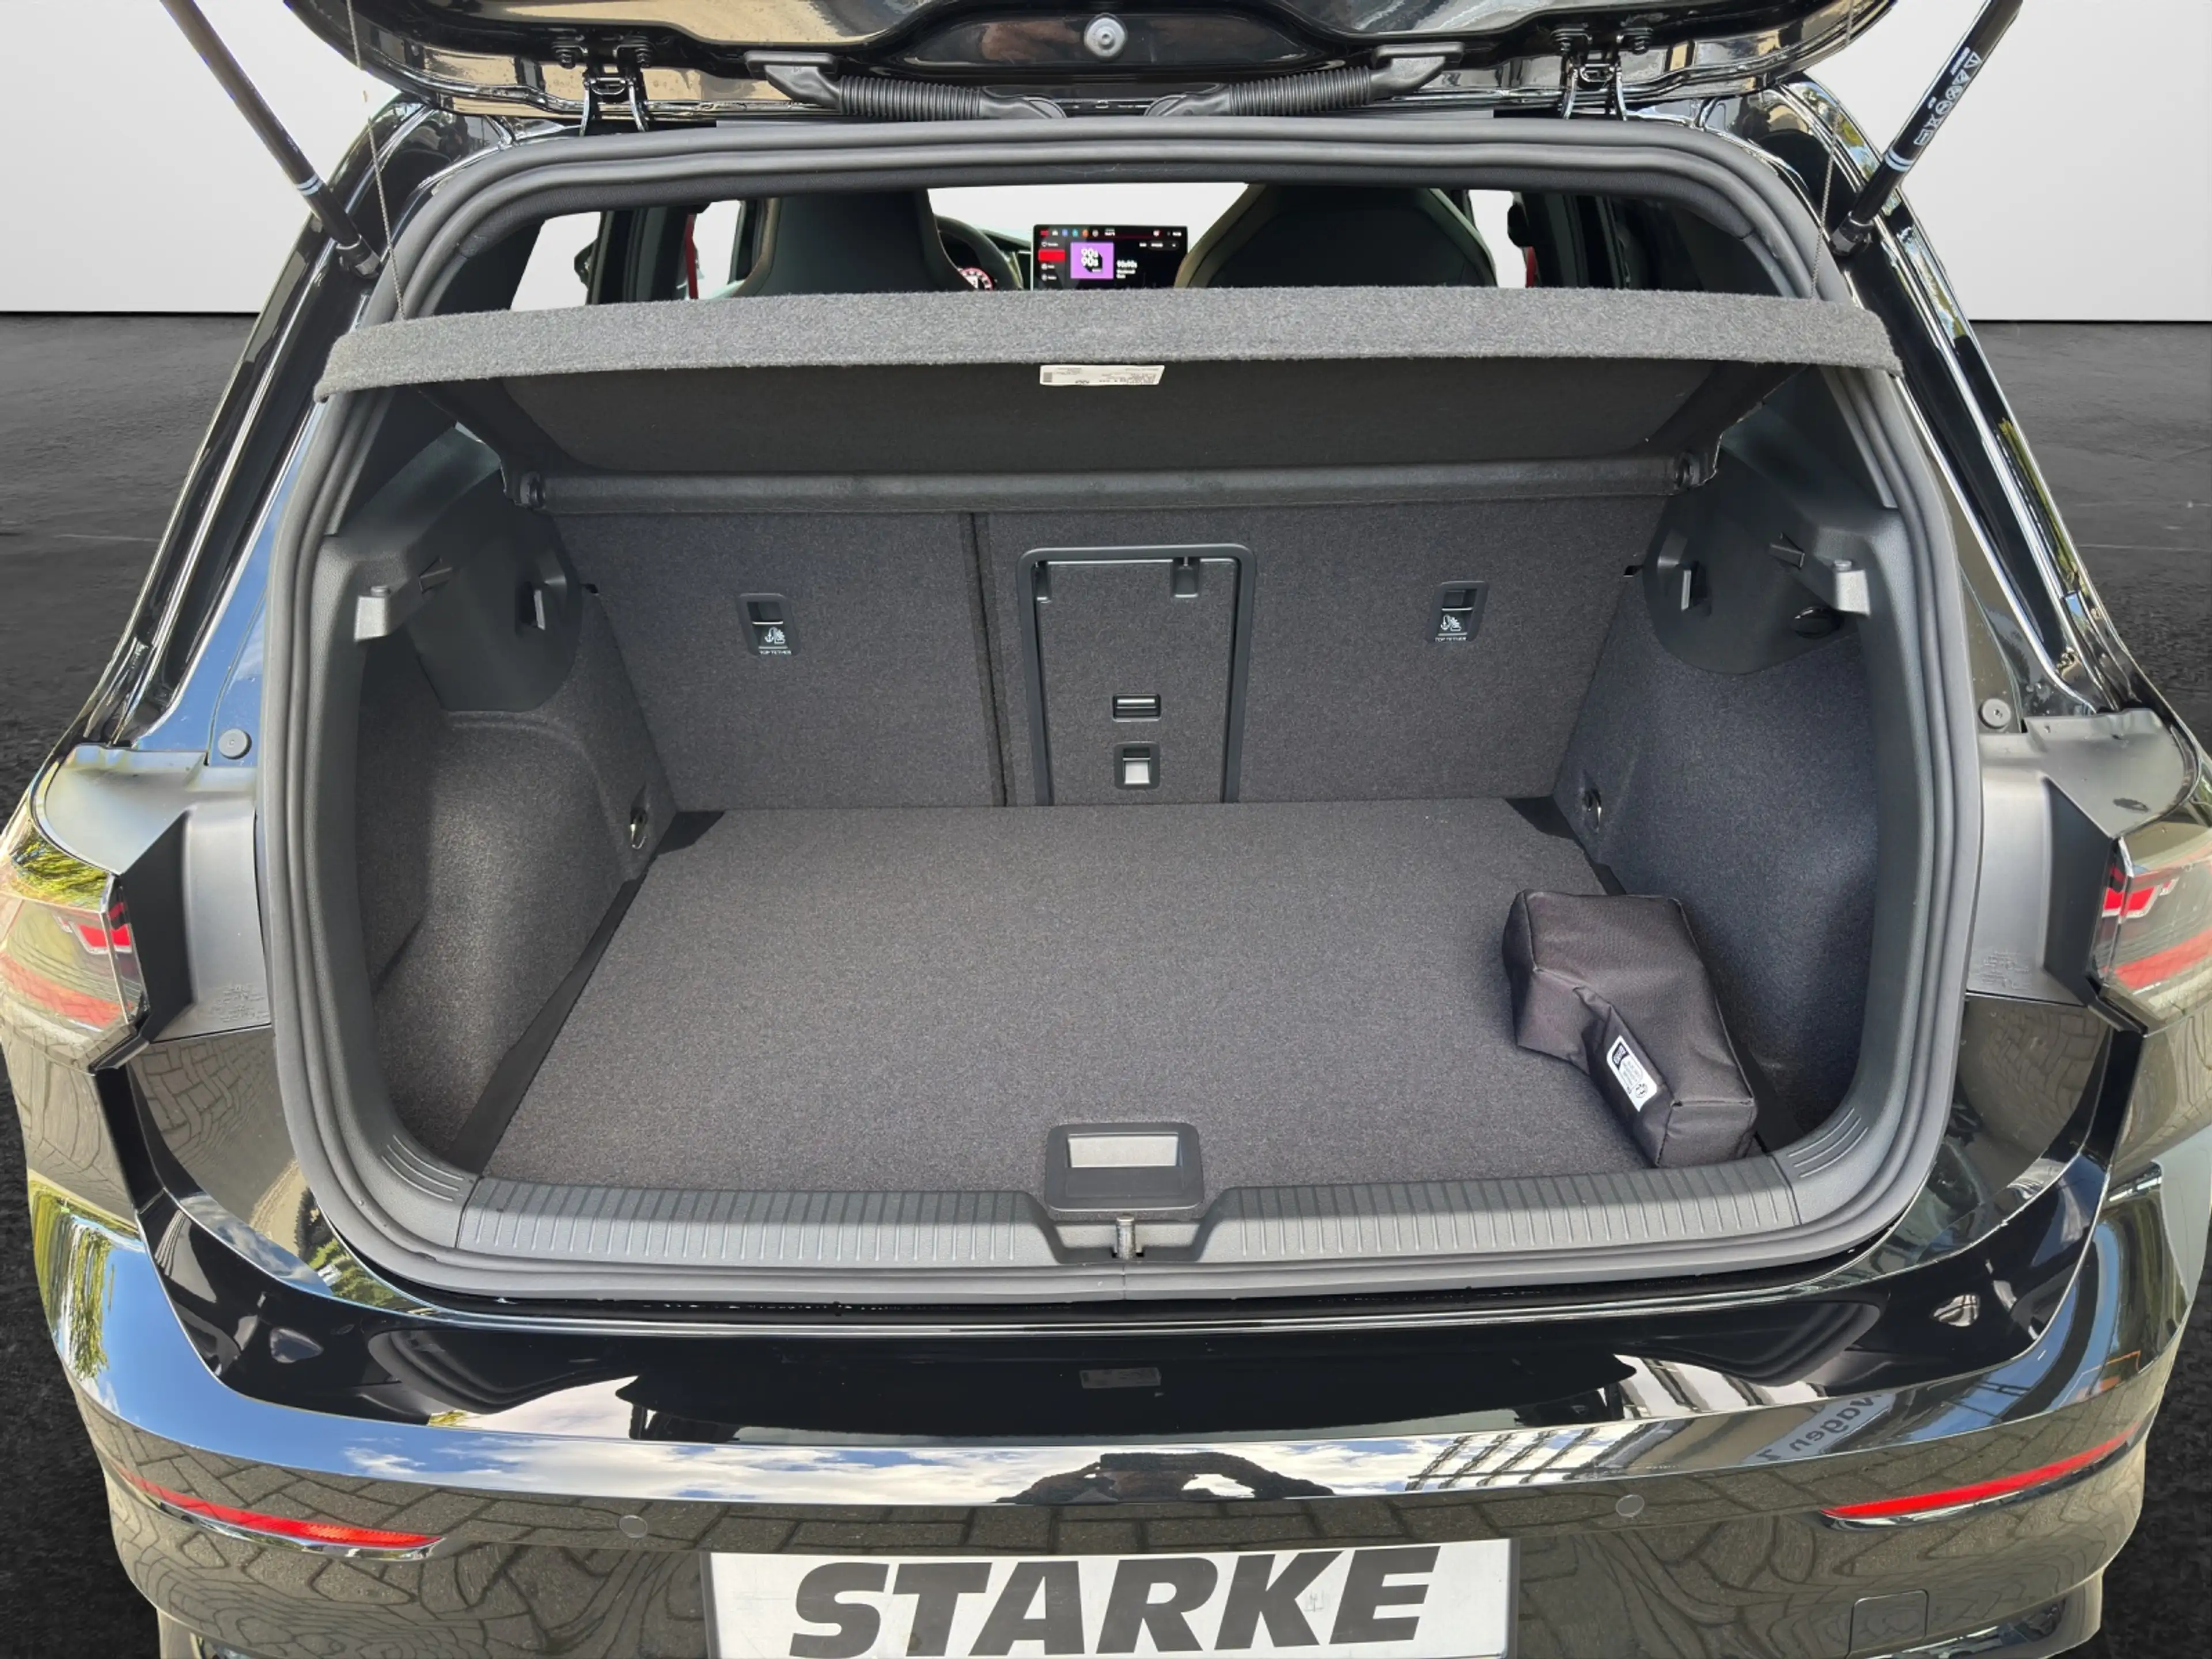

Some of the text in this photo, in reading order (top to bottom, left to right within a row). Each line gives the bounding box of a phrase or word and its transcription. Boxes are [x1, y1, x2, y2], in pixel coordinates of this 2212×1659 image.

[1081, 248, 1099, 258] 90s
[1081, 257, 1099, 267] 90s
[789, 1547, 1441, 1659] STARKE
